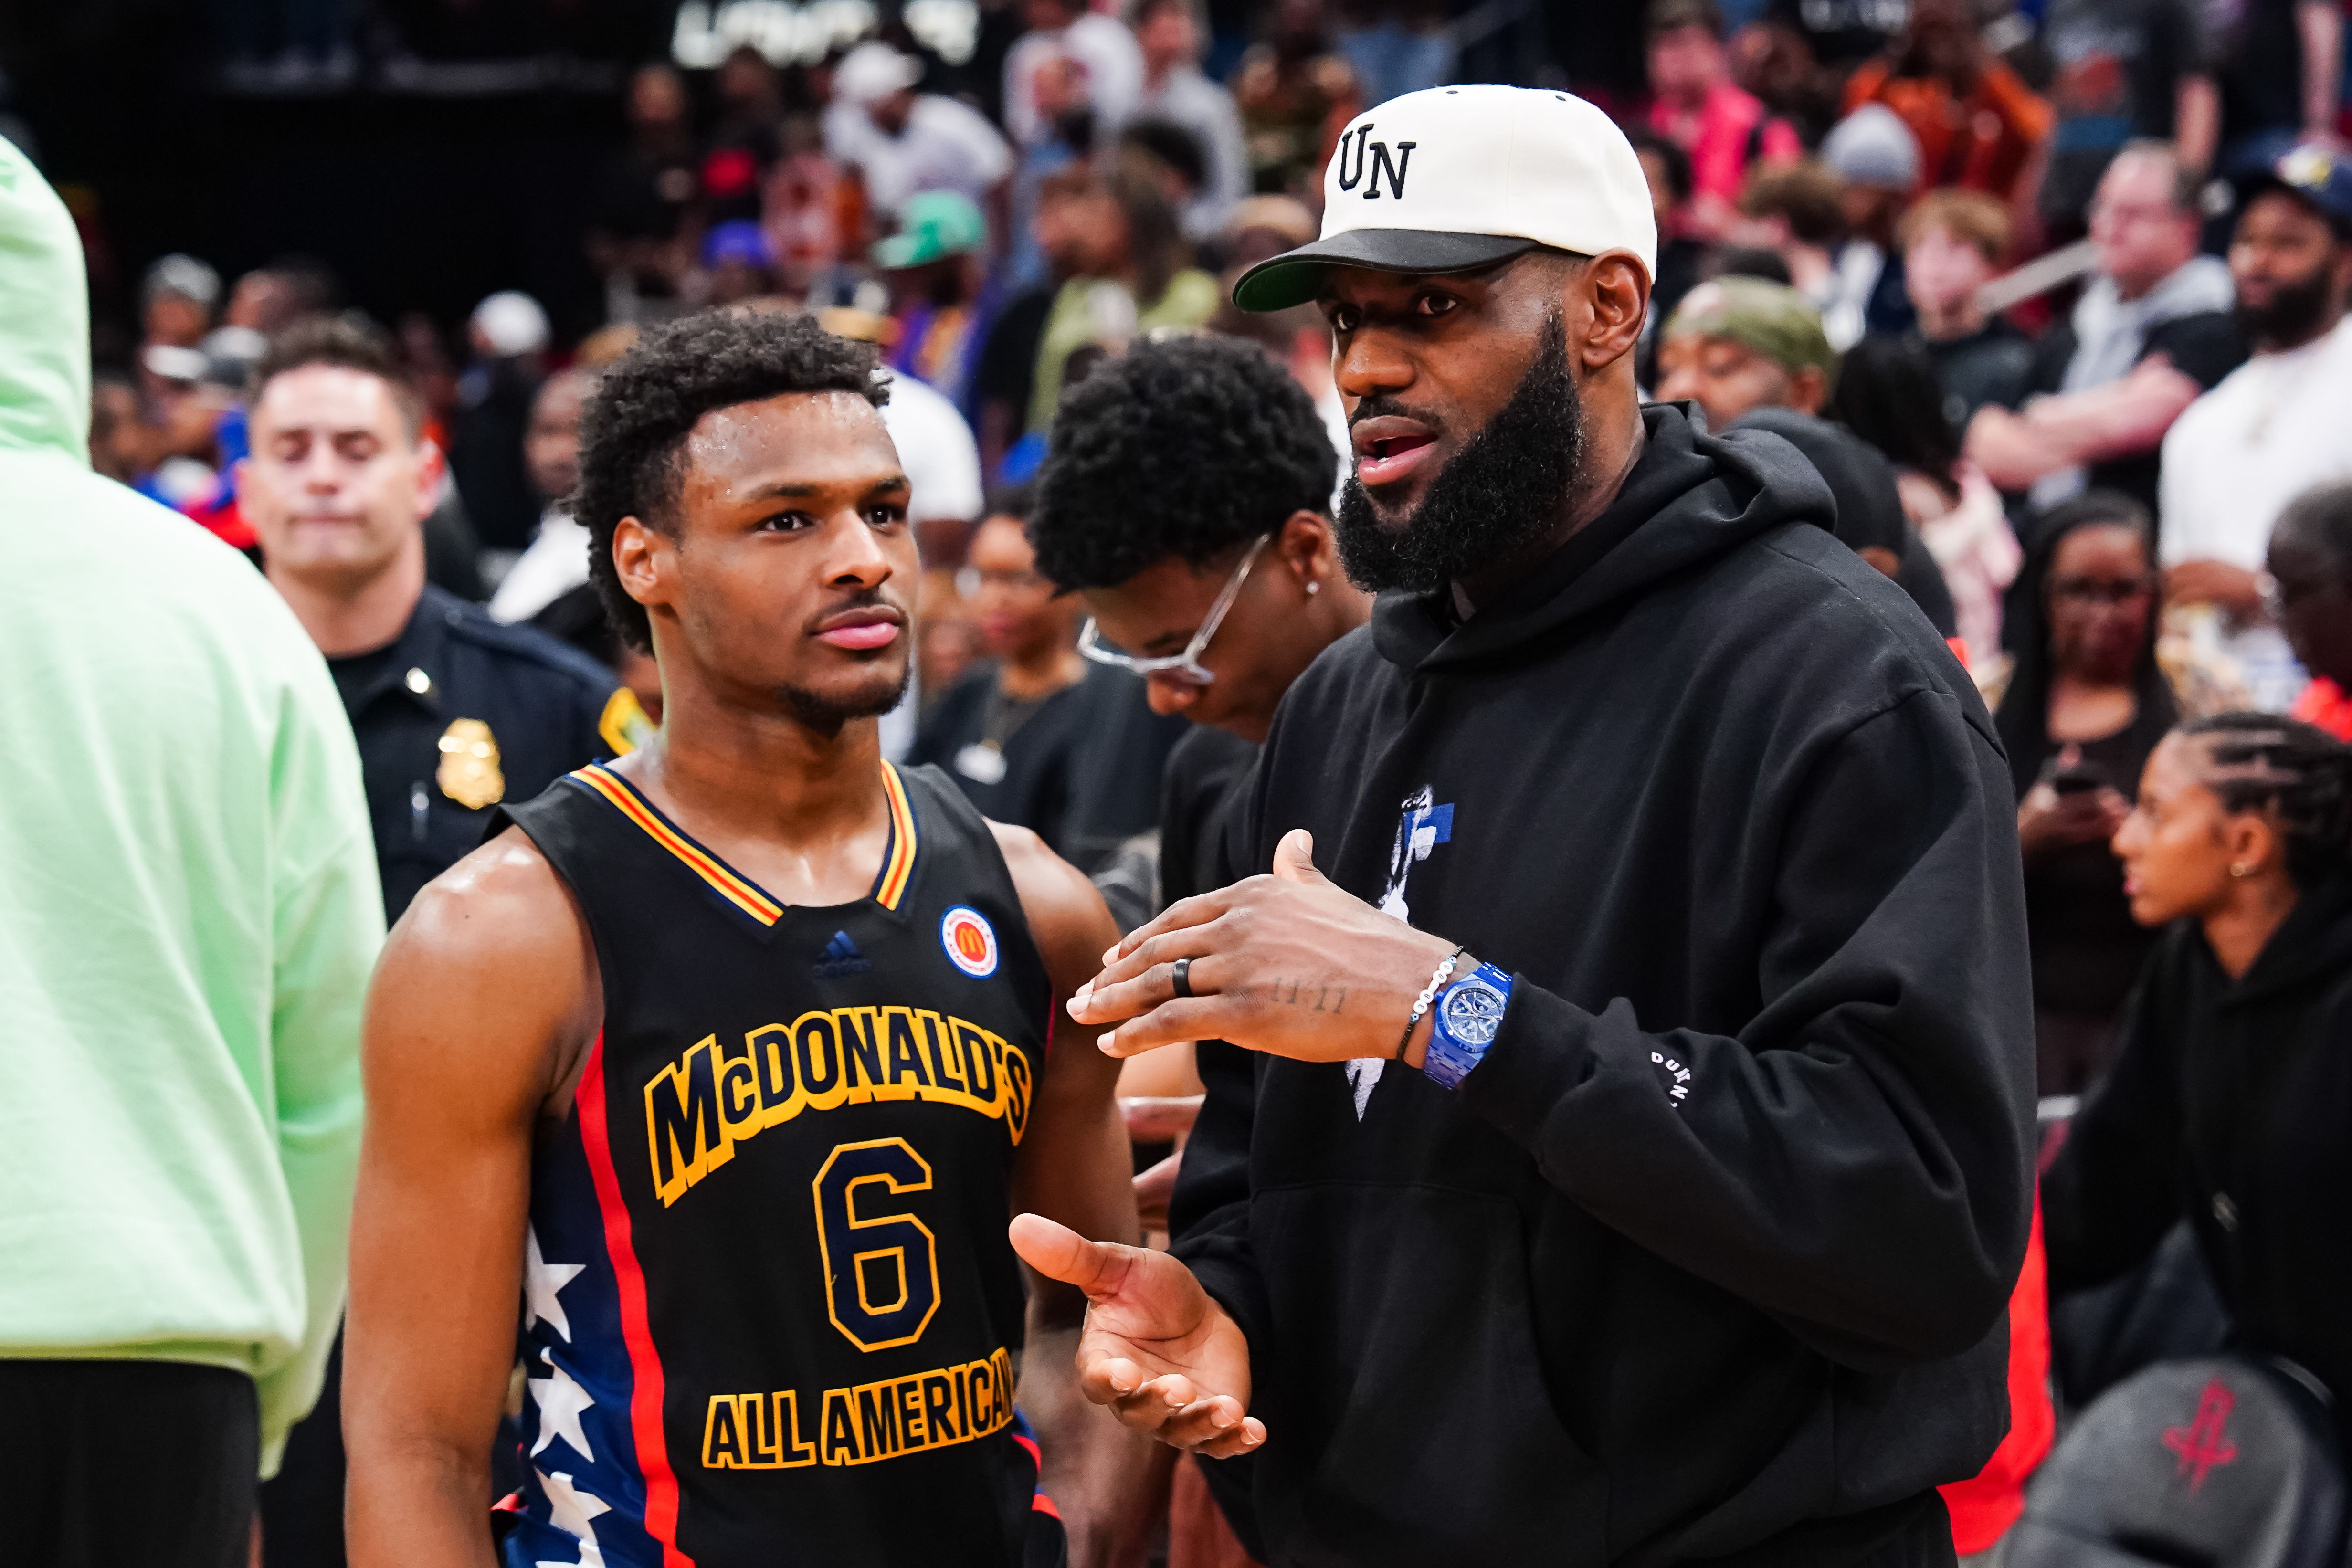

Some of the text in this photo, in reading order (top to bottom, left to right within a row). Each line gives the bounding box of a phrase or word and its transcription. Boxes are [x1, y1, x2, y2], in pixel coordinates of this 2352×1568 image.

[1339, 123, 1416, 200] UN
[812, 1137, 941, 1353] 6
[702, 1389, 817, 1470] ALL
